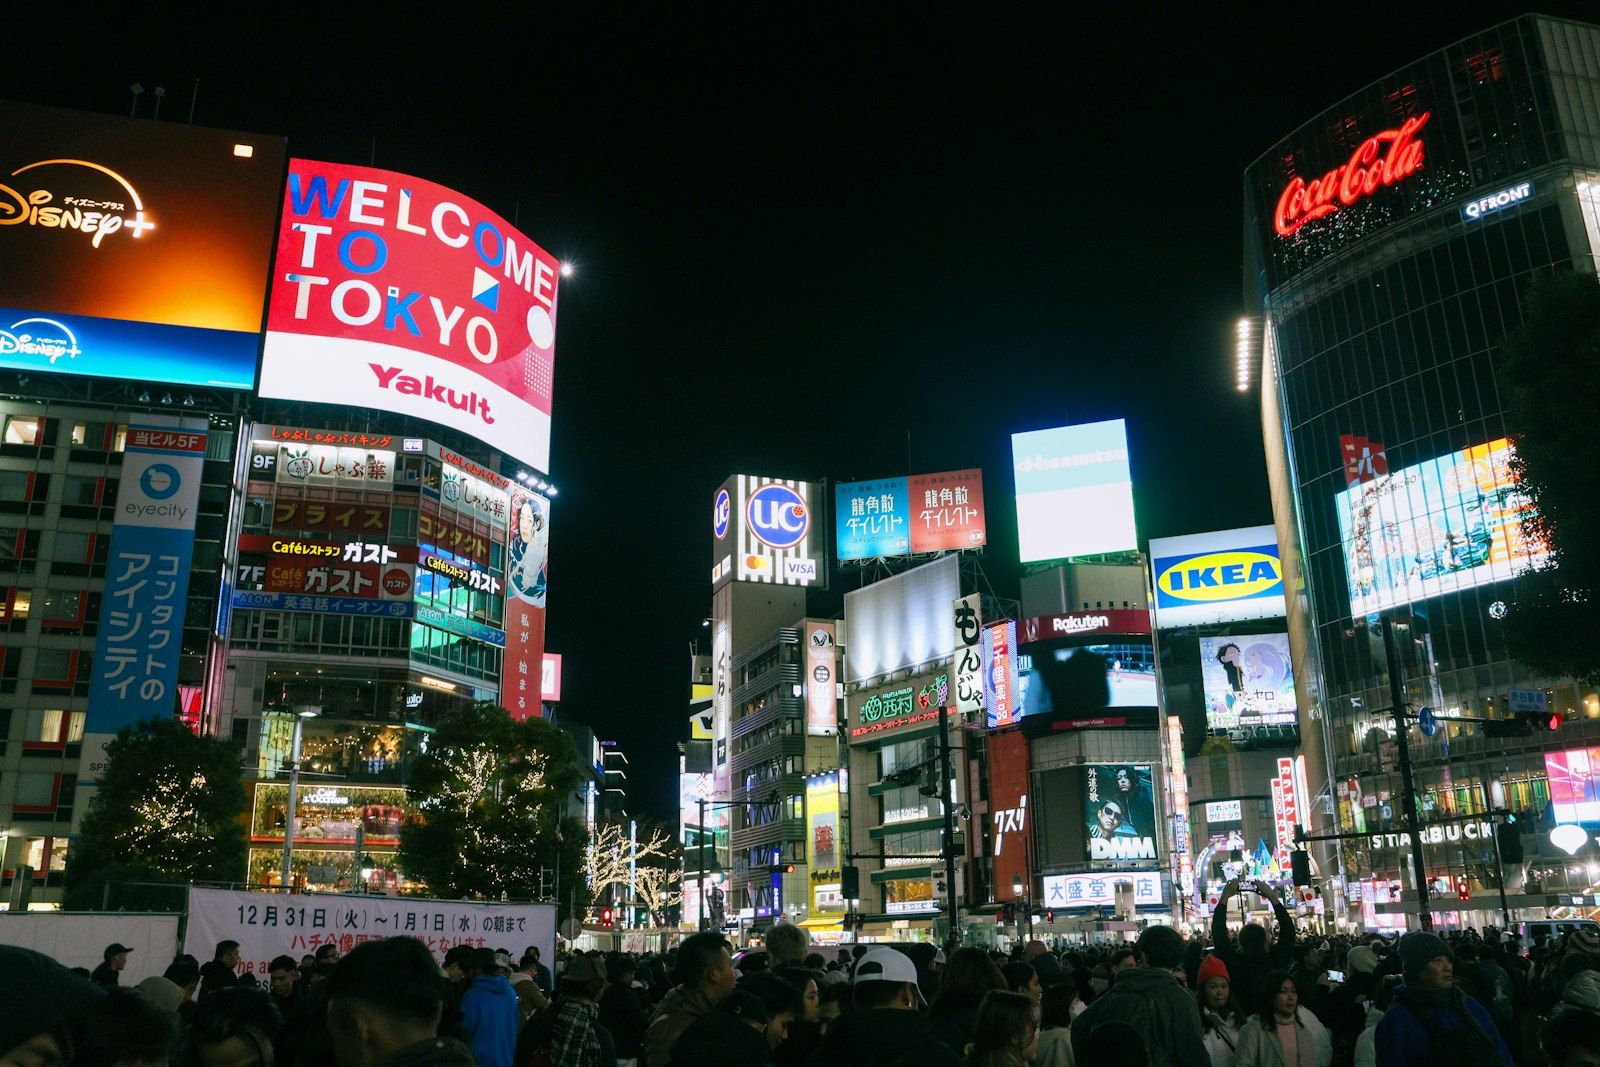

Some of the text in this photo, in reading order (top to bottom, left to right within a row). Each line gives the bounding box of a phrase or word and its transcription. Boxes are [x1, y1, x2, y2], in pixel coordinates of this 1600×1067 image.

[64, 196, 125, 211] ディズニープラス
[288, 172, 554, 308] WELCOME
[291, 223, 388, 275] TO
[285, 273, 499, 364] TOKYO
[368, 363, 495, 425] Yakult
[135, 431, 199, 449] 当ビル5F
[271, 427, 393, 448] しゃぶしゃぶバイキング
[253, 454, 276, 469] 9F
[319, 456, 387, 480] しゃぶ葉
[463, 484, 504, 518] しゃぶ葉
[851, 494, 894, 517] 龍角散
[924, 485, 968, 508] 龍角散
[125, 503, 189, 521] eyecity
[276, 503, 385, 529] プライス
[419, 516, 488, 558] コンタクト
[343, 542, 398, 564] ガスト
[239, 566, 266, 582] 7F
[789, 562, 814, 574] VISA
[1169, 560, 1279, 591] IKEA
[304, 567, 373, 595] ガスト
[386, 580, 408, 588] ガスト
[469, 569, 500, 595] ガスト
[240, 593, 272, 604] AEON
[284, 595, 384, 613] 英会話イーオン
[104, 553, 151, 699] アイシティ
[140, 556, 179, 701] コンタクトの
[1053, 615, 1109, 632] Rakuten
[955, 600, 983, 707] もんじゃ
[883, 694, 913, 718] 西村
[1281, 766, 1295, 816] カラオケ
[1091, 836, 1156, 859] DMM
[1051, 878, 1153, 901] 大盛堂店
